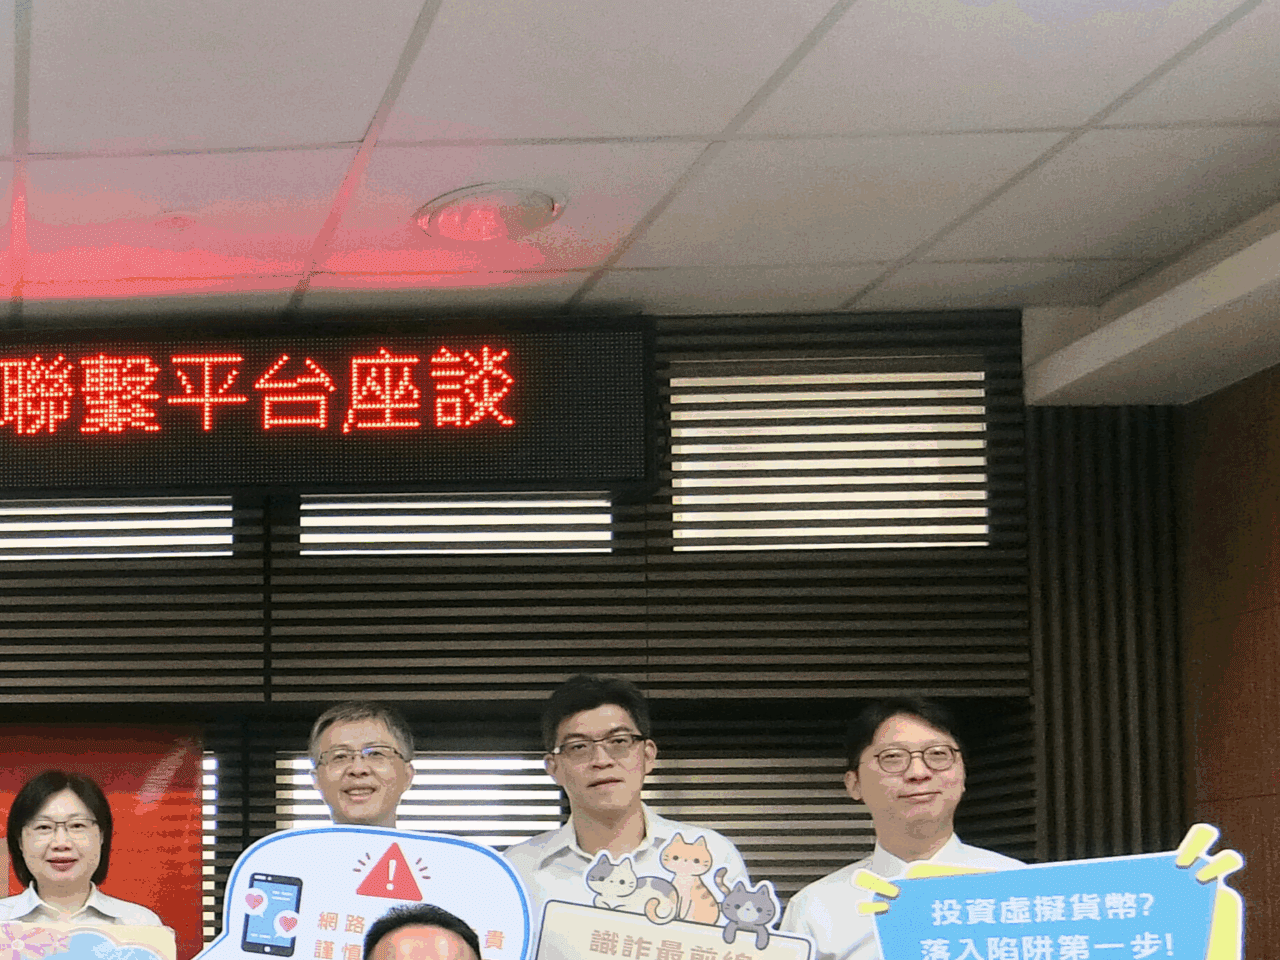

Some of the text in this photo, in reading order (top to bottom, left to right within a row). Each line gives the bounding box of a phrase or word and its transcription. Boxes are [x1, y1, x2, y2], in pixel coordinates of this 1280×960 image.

[931, 892, 1155, 927] 投資虛擬貨幣?
